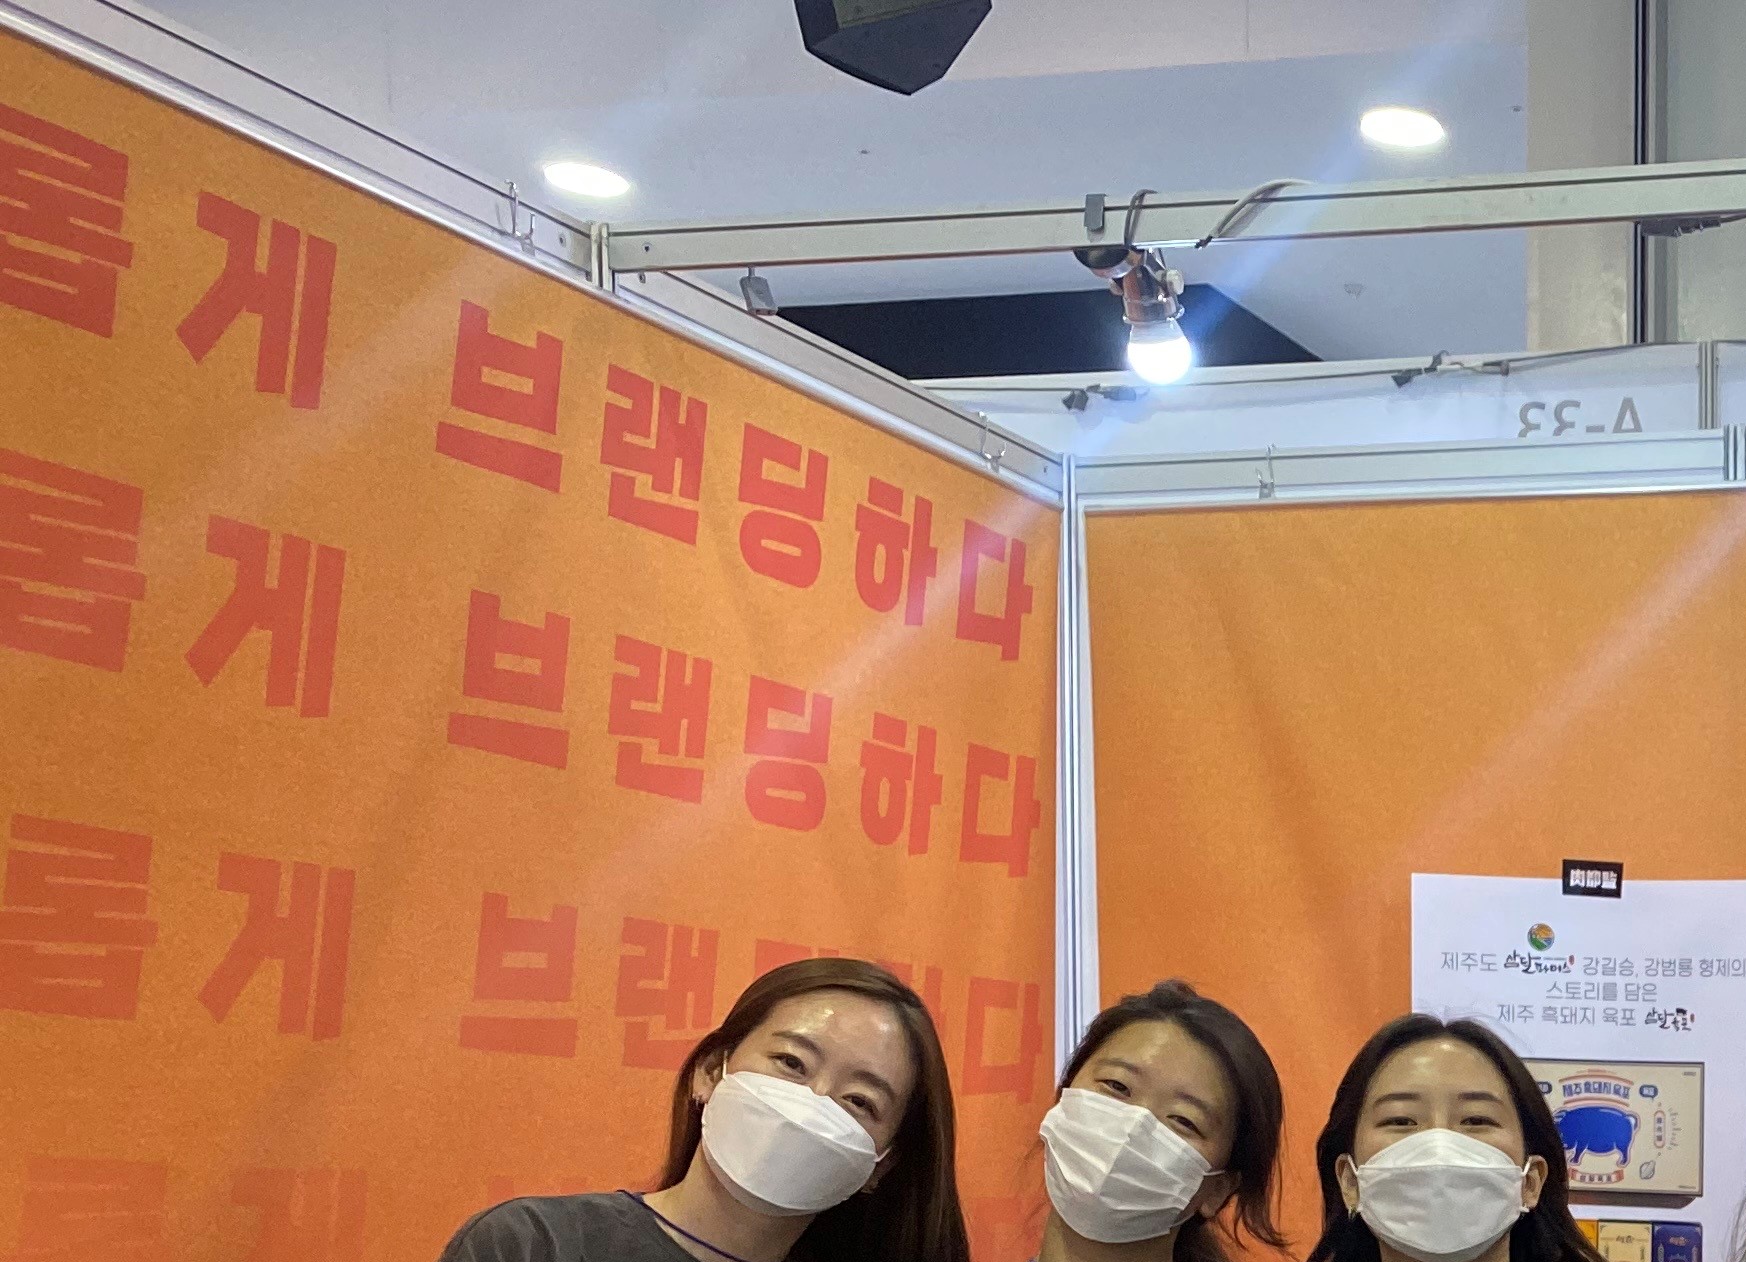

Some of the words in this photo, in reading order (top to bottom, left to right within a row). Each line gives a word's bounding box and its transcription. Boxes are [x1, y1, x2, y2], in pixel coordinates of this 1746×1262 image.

[434, 299, 1034, 662] 브랜딩하다
[447, 589, 1041, 877] 브랜딩하다
[458, 892, 1044, 1103] 브랜다
[1441, 951, 1499, 973] 제주도
[1582, 956, 1638, 978] 강길승,
[1644, 957, 1694, 978] 강범룡
[1699, 957, 1746, 978] 형제의
[1497, 1004, 1535, 1024] 제주
[1541, 1006, 1596, 1026] 흑돼지
[1602, 1007, 1637, 1027] 육포
[1545, 981, 1618, 1002] 스토리를
[1624, 981, 1658, 1002] 담은
